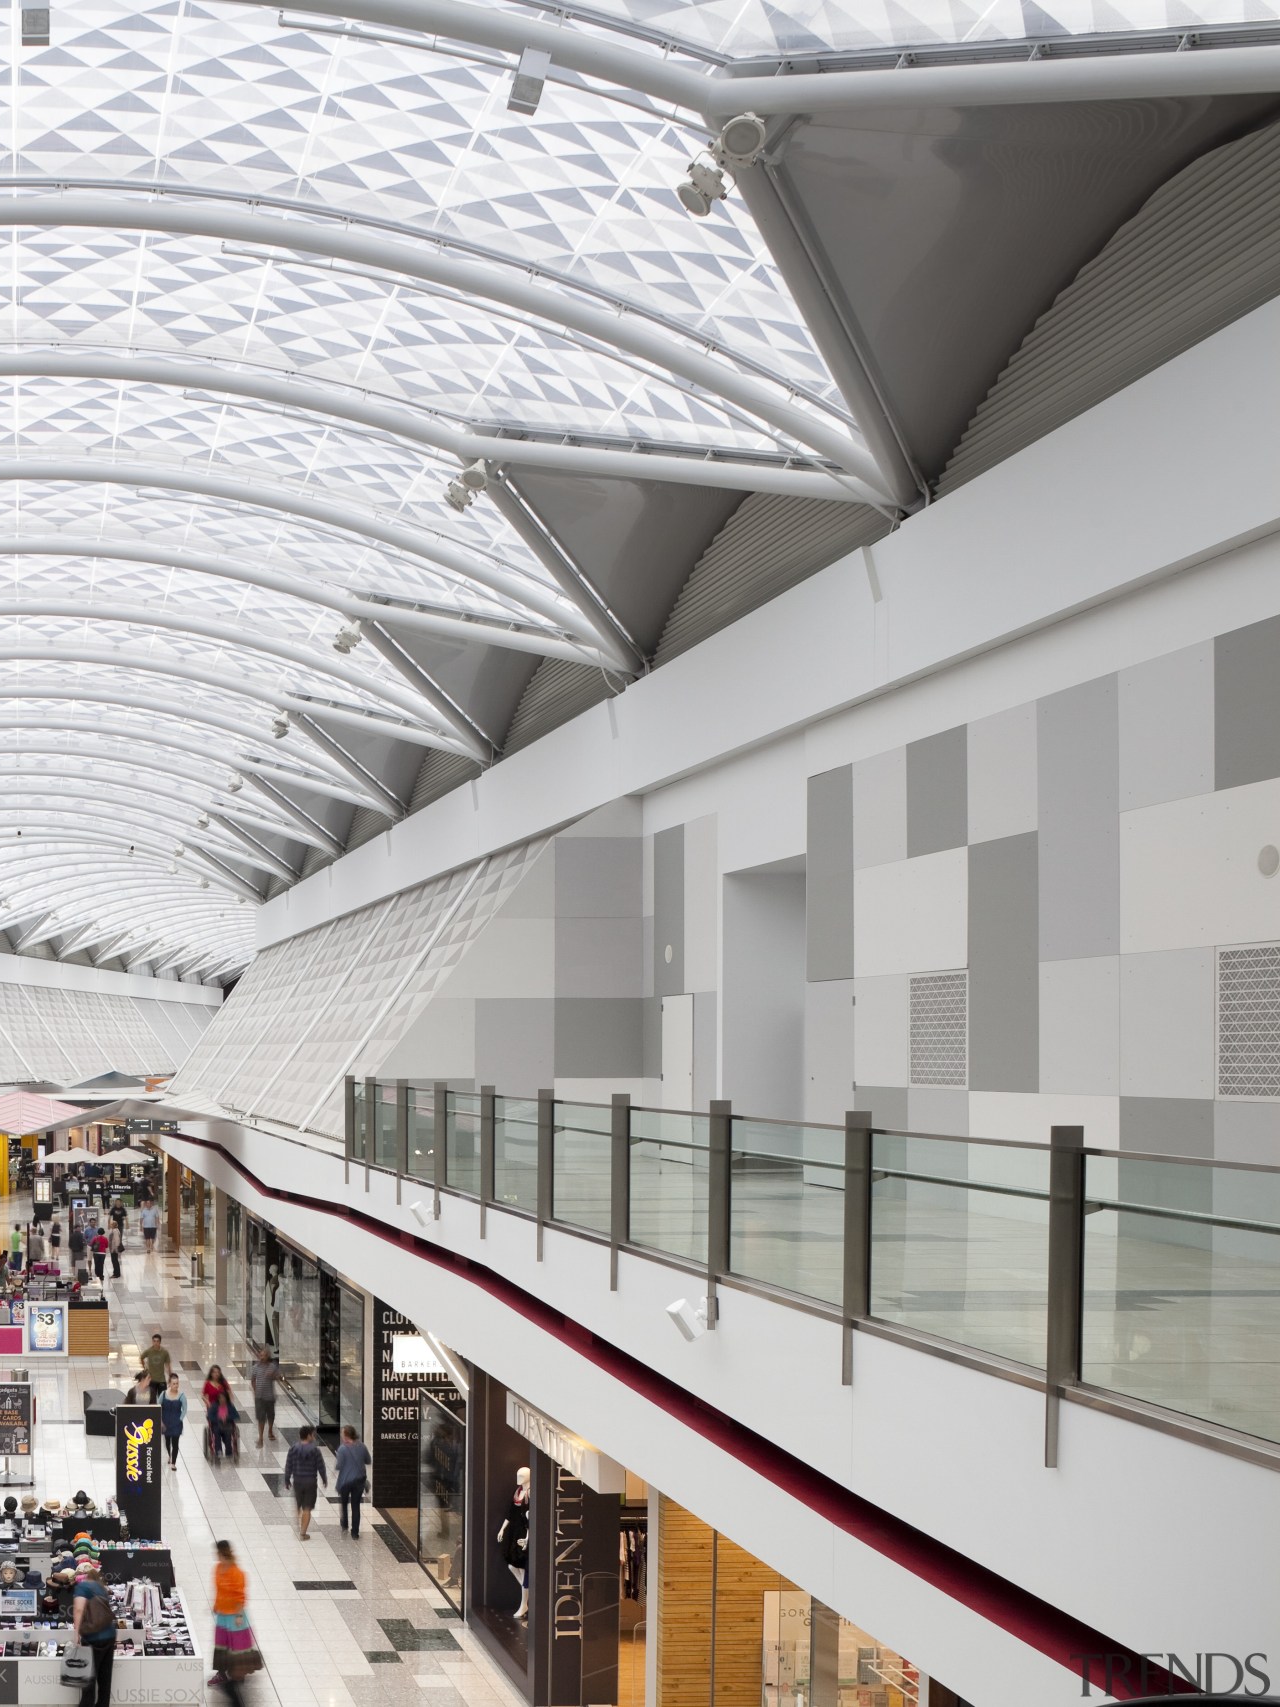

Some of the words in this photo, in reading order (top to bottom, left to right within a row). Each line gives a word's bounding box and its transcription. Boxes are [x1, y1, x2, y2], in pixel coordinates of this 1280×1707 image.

[37, 1314, 54, 1326] $3
[124, 1422, 143, 1482] Aussie
[554, 1466, 584, 1640] IDENTIT
[104, 1572, 121, 1581] OX
[164, 1688, 201, 1702] SOX
